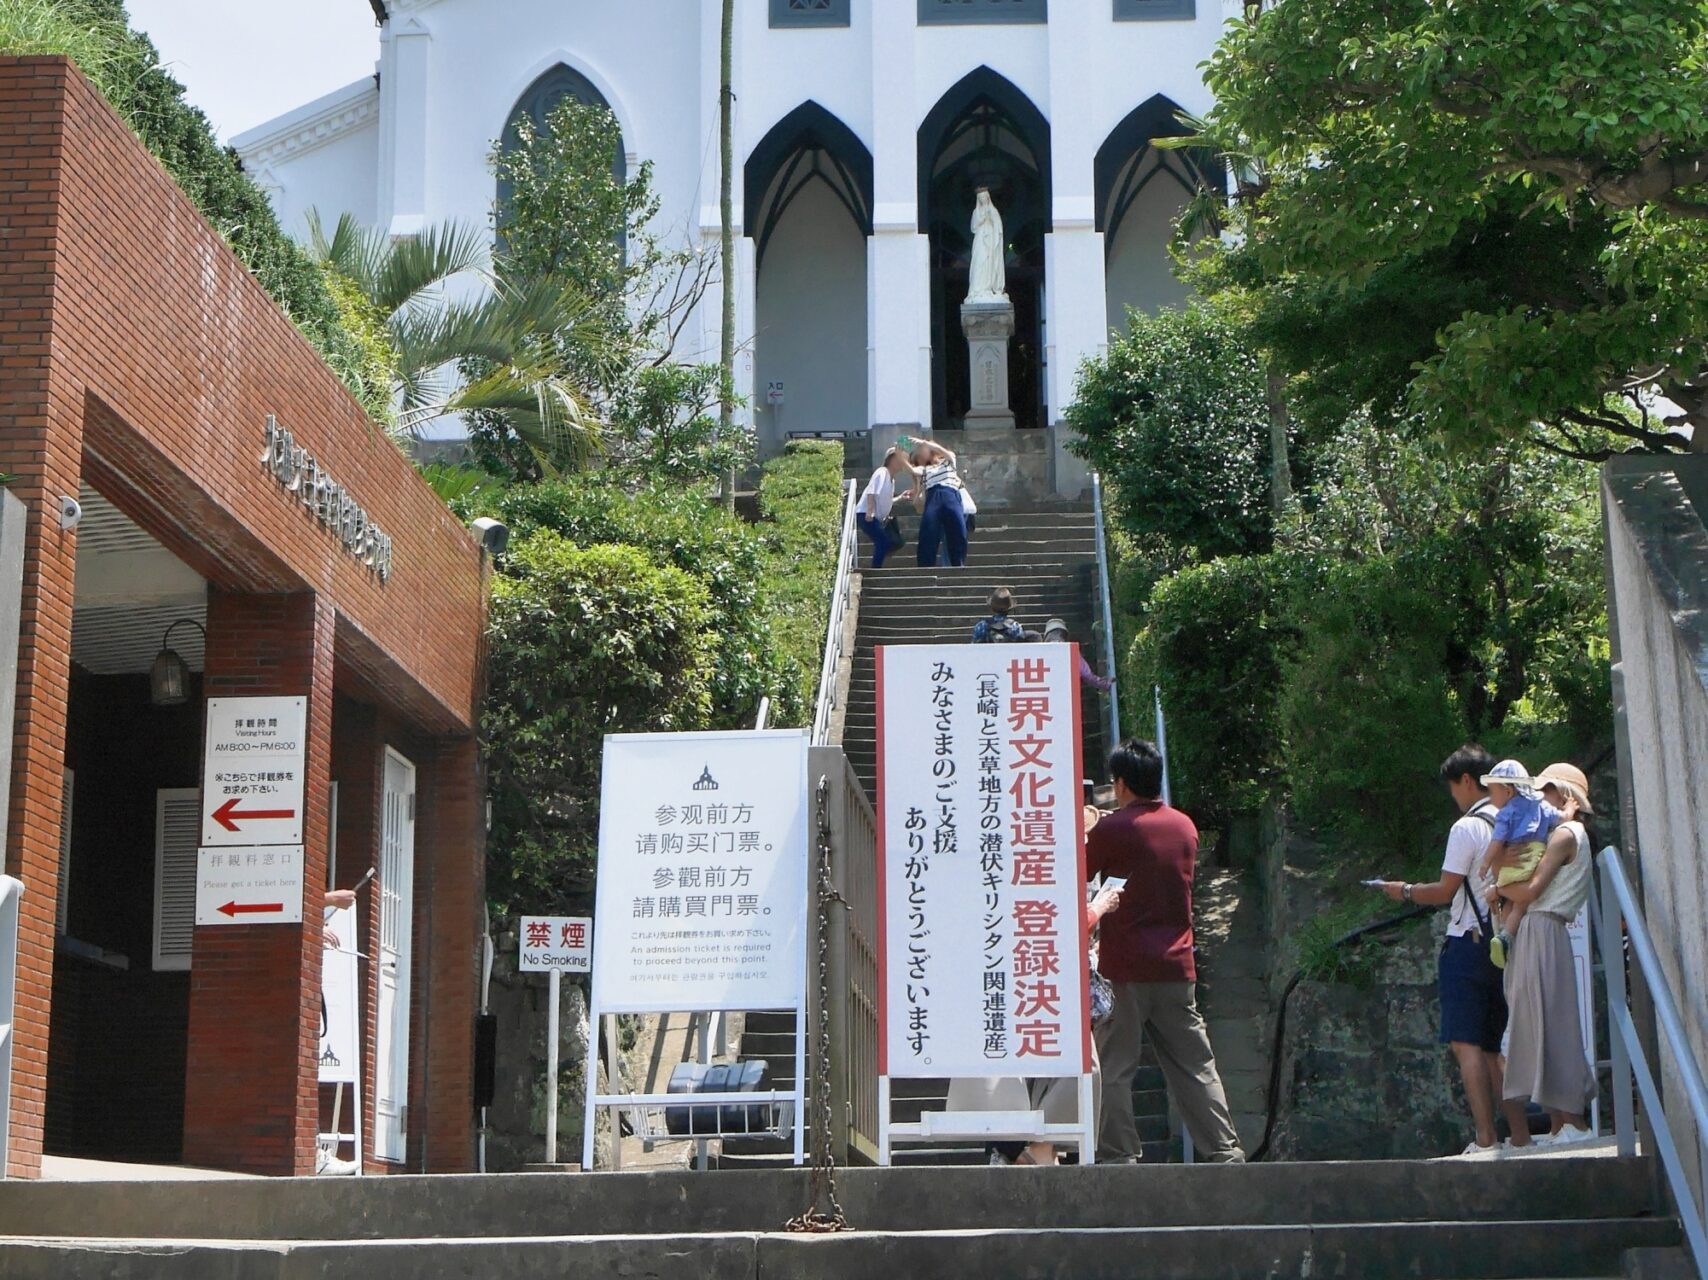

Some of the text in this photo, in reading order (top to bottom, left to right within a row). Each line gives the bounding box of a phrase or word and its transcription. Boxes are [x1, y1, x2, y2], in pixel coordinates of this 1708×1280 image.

[768, 382, 783, 390] 入口
[234, 717, 278, 728] 拝観時間
[931, 661, 957, 854] みなさまのご支援
[654, 802, 755, 826] 参观前方
[635, 831, 775, 855] 请购买门票。
[210, 853, 292, 867] 拝観料窓口
[1006, 658, 1062, 1059] 世界文化遺産 登録決定
[204, 879, 227, 888] Please
[231, 879, 244, 889] get
[255, 878, 277, 887] ticket
[279, 878, 296, 886] here
[652, 865, 754, 889] 參觀前方
[633, 894, 774, 919] 請購買門票。
[526, 921, 586, 948] 禁煙
[904, 806, 932, 1066] ありがとうございます。
[523, 953, 587, 966] No Smoking
[630, 946, 643, 954] An
[646, 945, 691, 953] admission
[694, 944, 720, 952] ticket
[734, 943, 771, 953] required
[645, 957, 682, 966] proceed
[684, 956, 718, 965] beyond
[721, 956, 739, 964] this
